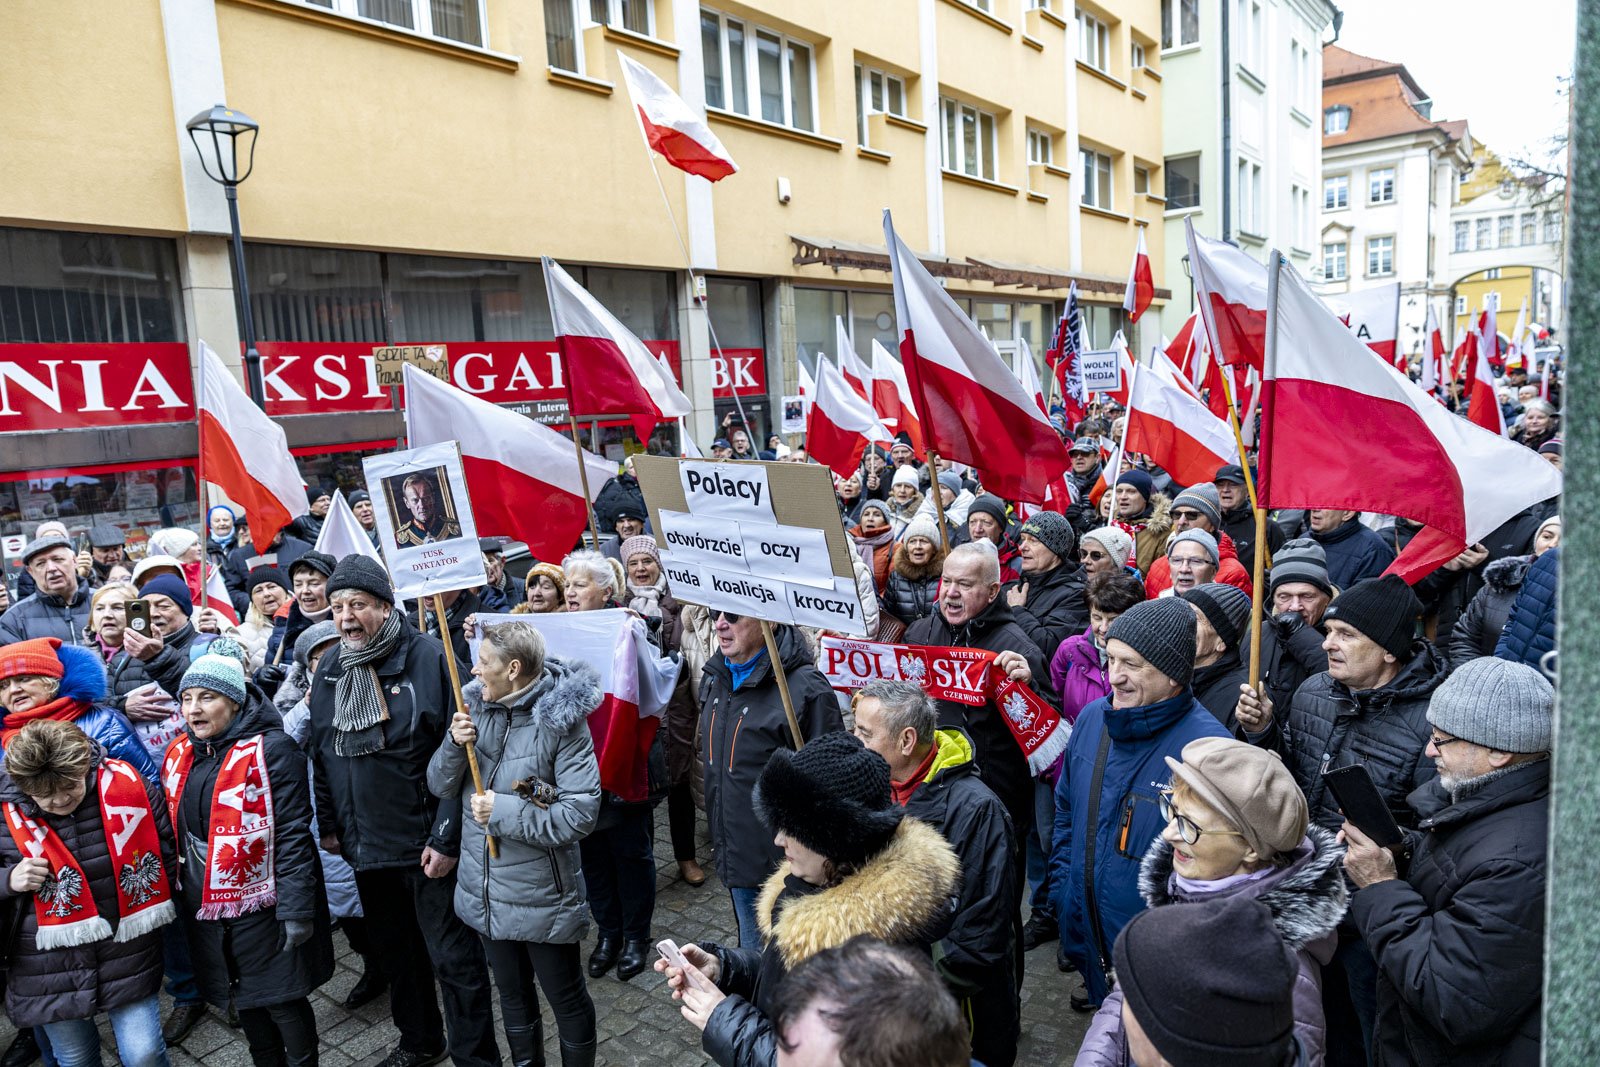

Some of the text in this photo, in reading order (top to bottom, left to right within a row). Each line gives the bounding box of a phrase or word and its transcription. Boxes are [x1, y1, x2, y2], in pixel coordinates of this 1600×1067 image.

[376, 347, 427, 362] GDZIE TA
[1084, 361, 1114, 370] WOLNE
[1084, 372, 1115, 381] MEDIA
[0, 358, 189, 416] NIA
[686, 470, 761, 506] Polacy
[421, 548, 445, 559] TUSK
[666, 531, 800, 563] otwórzcie oczy
[412, 556, 459, 572] DYKTATOR
[667, 568, 855, 620] ruda koalicja kroczy
[841, 641, 986, 660] ZAWSZE WIERNI
[1025, 719, 1056, 750] POLSKA
